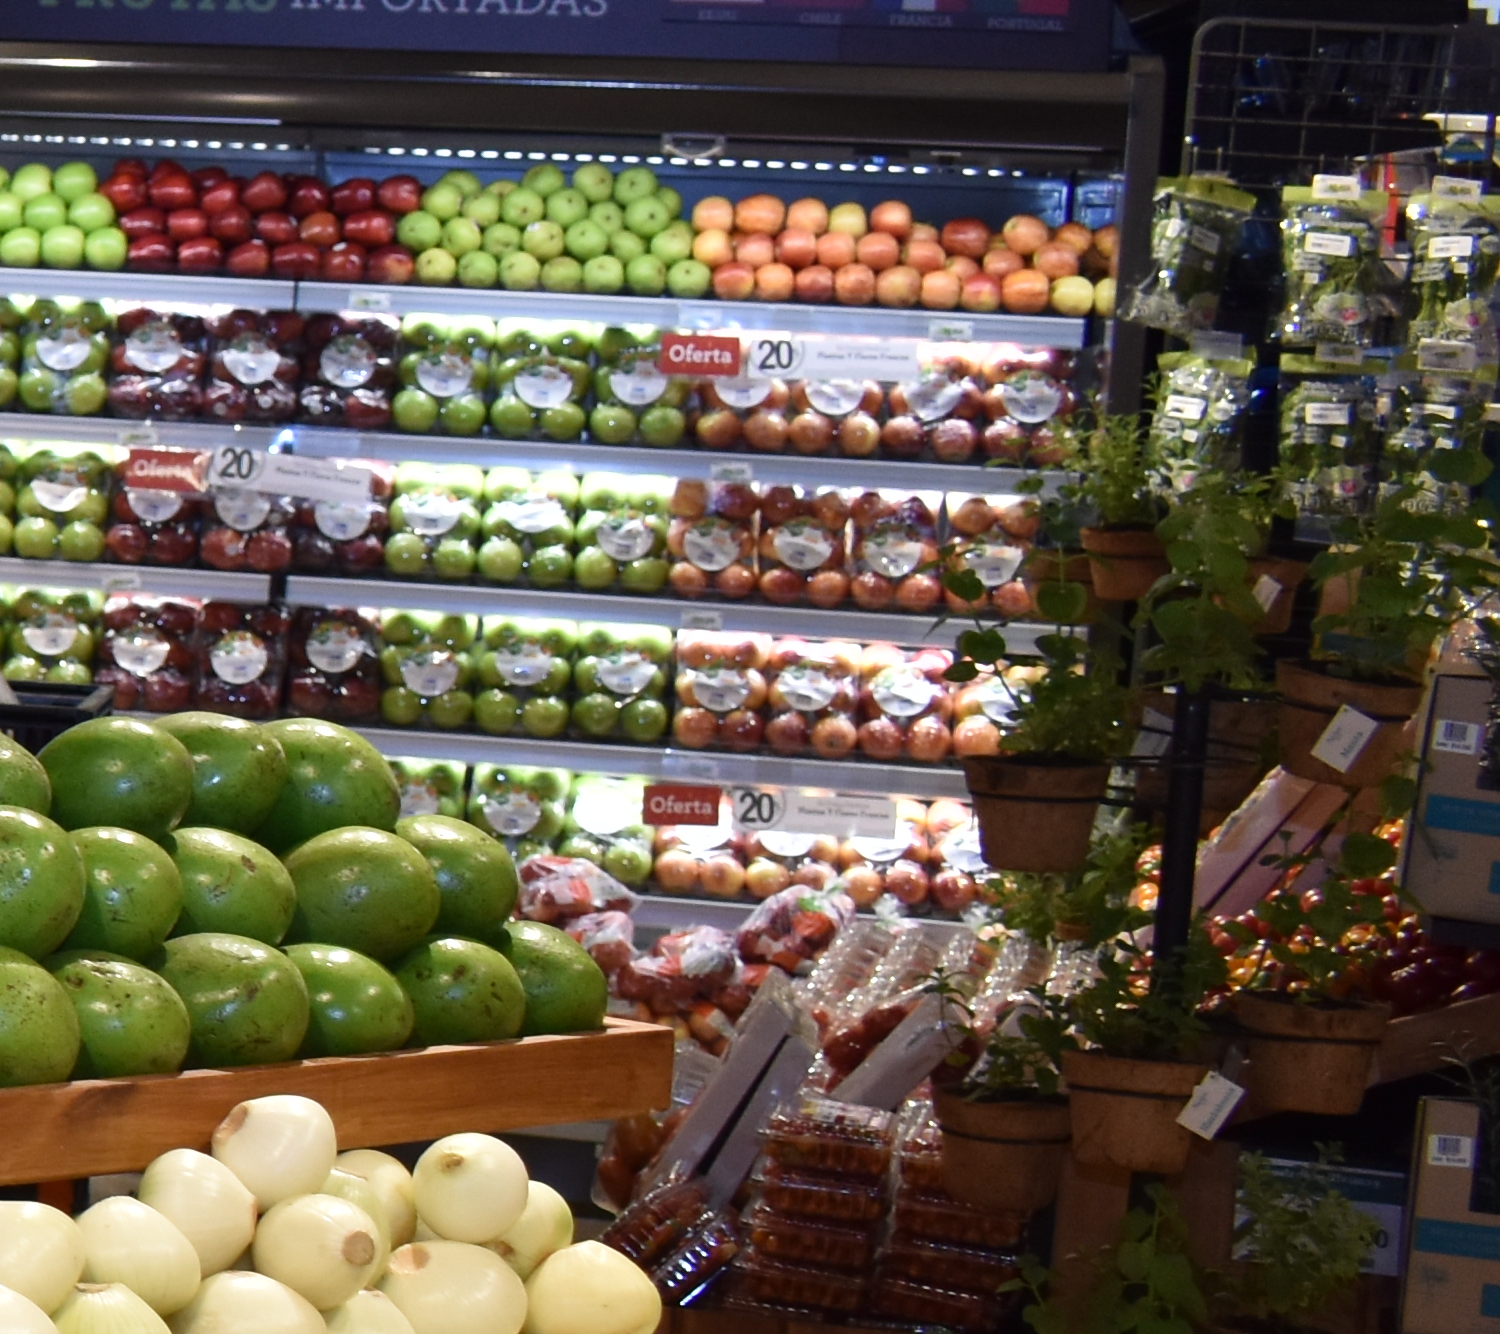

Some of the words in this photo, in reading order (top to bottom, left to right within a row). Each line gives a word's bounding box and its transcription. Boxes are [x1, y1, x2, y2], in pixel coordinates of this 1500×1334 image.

[668, 343, 733, 365] Oferta
[757, 339, 794, 371] 20
[650, 794, 714, 817] Oferta
[738, 790, 776, 825] 20
